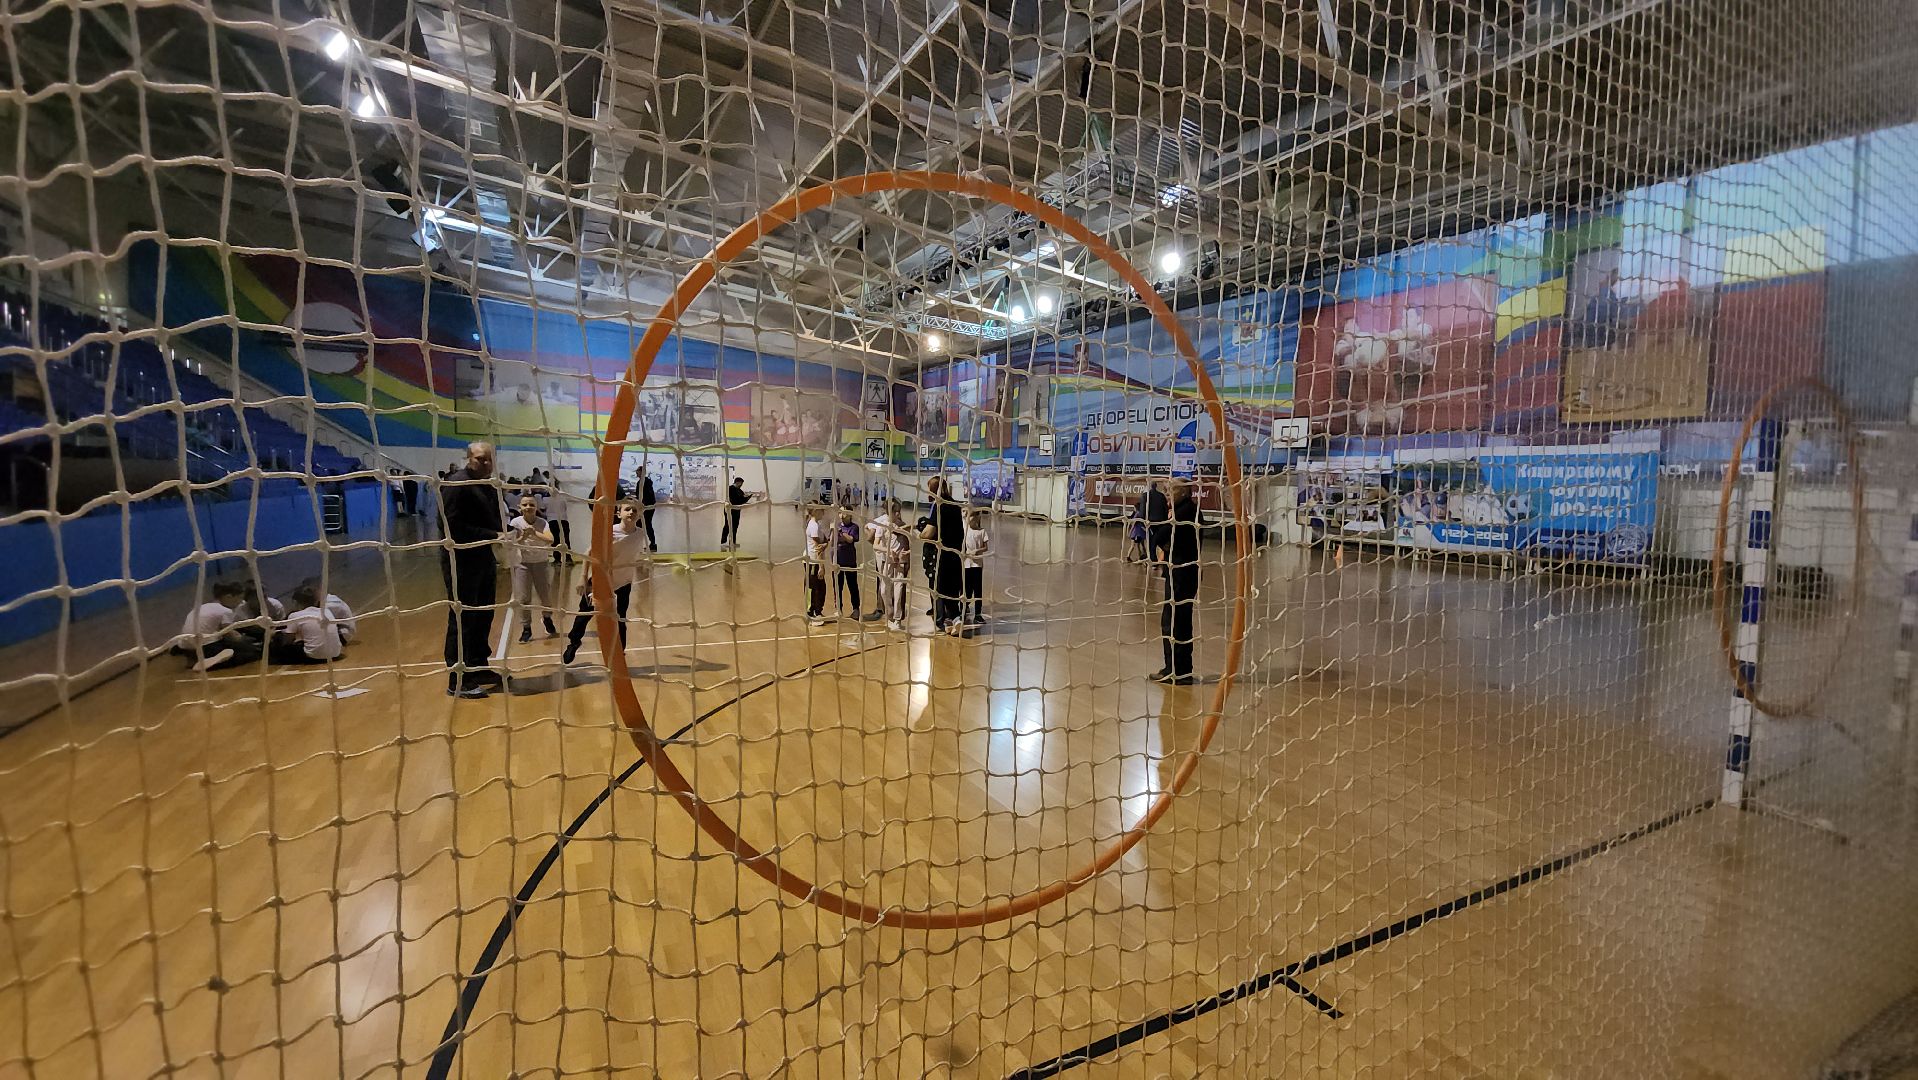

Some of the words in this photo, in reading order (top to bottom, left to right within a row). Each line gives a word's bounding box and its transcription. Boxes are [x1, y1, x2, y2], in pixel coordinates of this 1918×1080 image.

[1086, 408, 1148, 428] ДВОРЕЦ
[1518, 463, 1635, 482] Каширскому
[1551, 501, 1586, 517] 100
